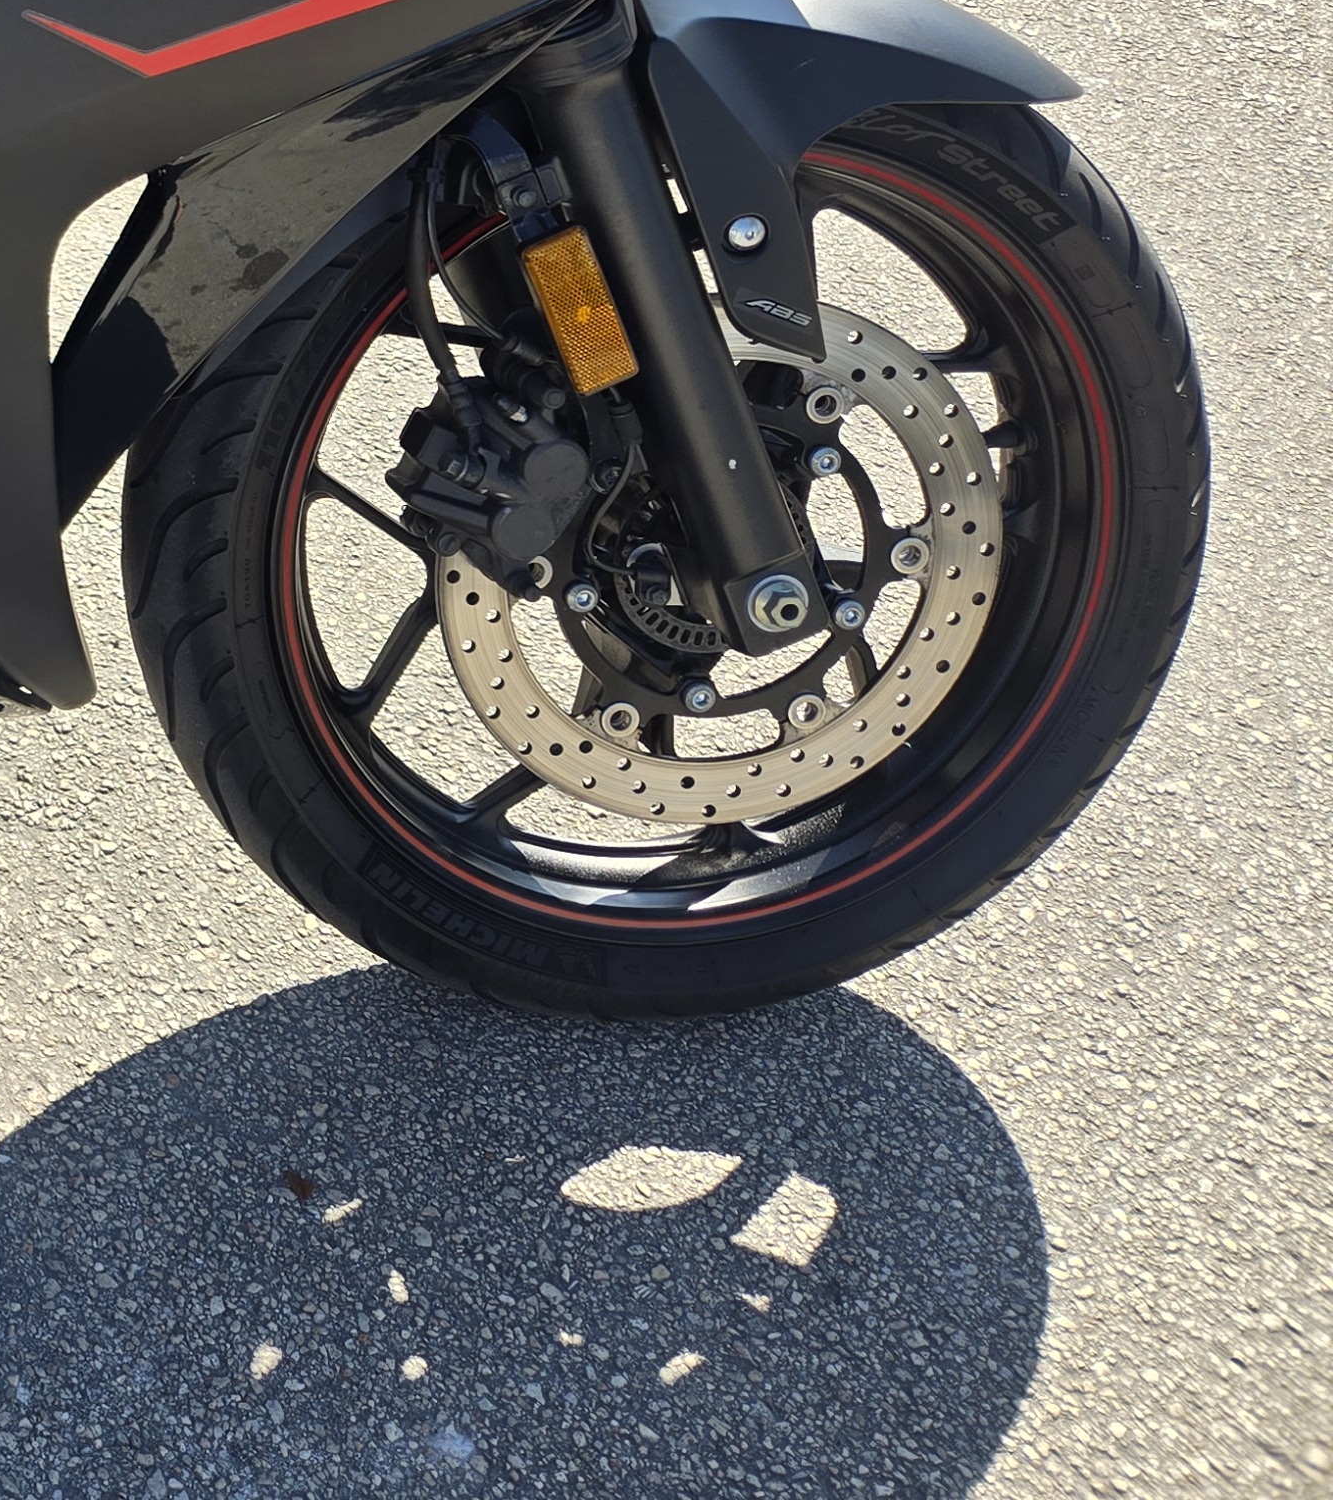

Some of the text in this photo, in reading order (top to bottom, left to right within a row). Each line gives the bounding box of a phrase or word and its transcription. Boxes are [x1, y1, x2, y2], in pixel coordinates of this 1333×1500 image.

[840, 109, 957, 142] ilot
[745, 300, 813, 327] ABS
[367, 862, 549, 967] MICHELIN
